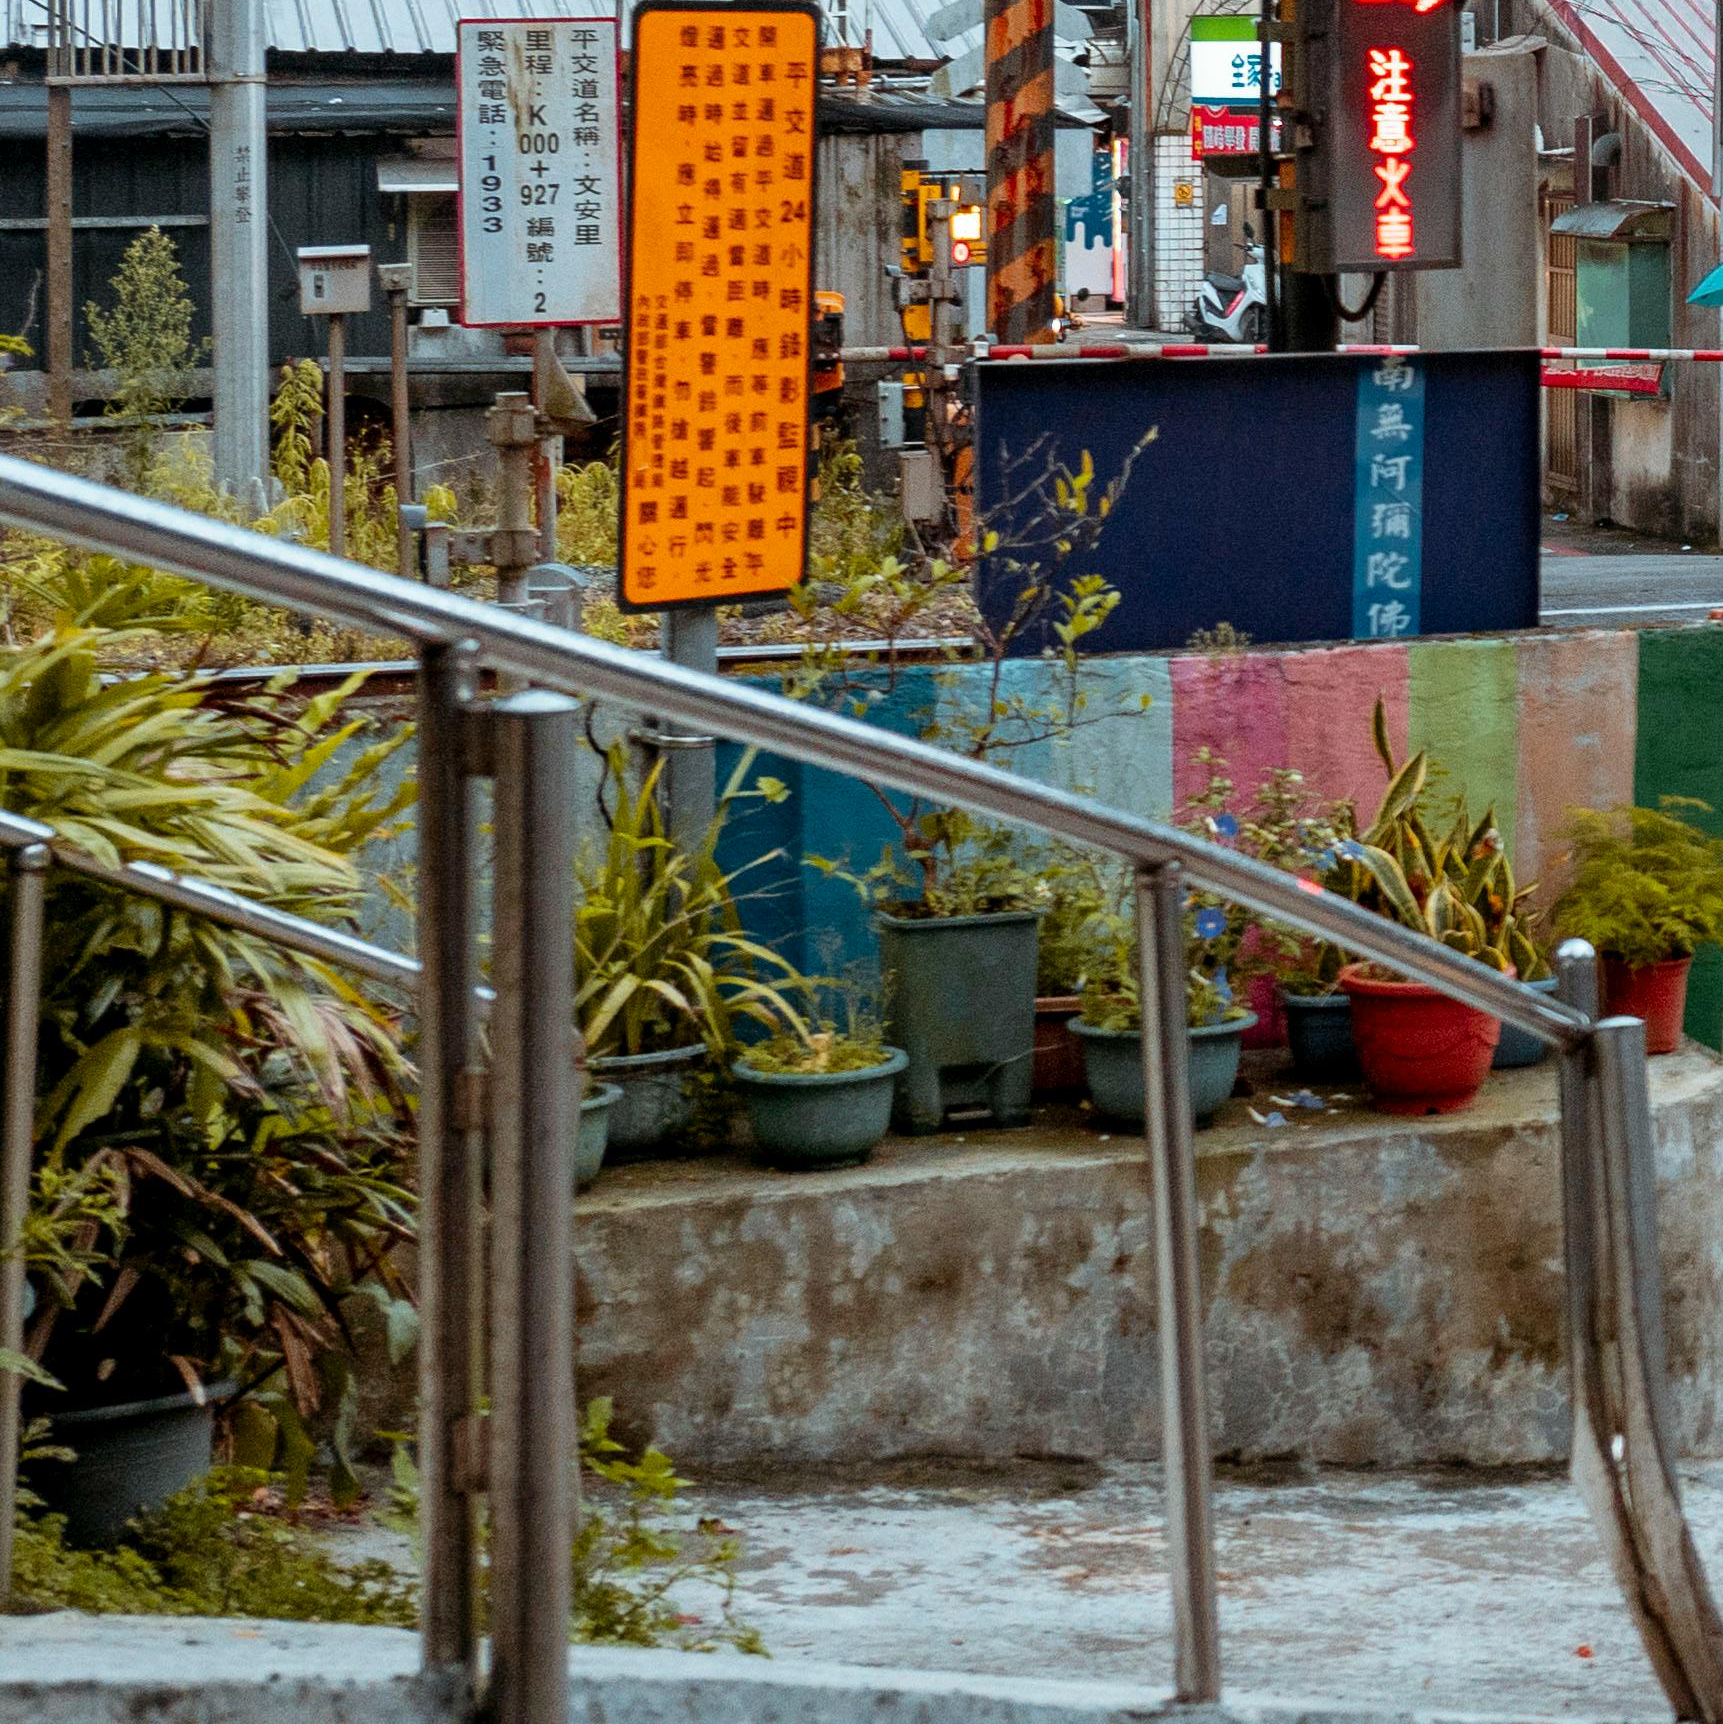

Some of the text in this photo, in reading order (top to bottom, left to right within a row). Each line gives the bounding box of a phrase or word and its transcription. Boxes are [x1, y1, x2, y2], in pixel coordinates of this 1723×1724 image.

[1368, 48, 1416, 258] 注意火車
[1364, 356, 1417, 635] 南無阿彌陀佛
